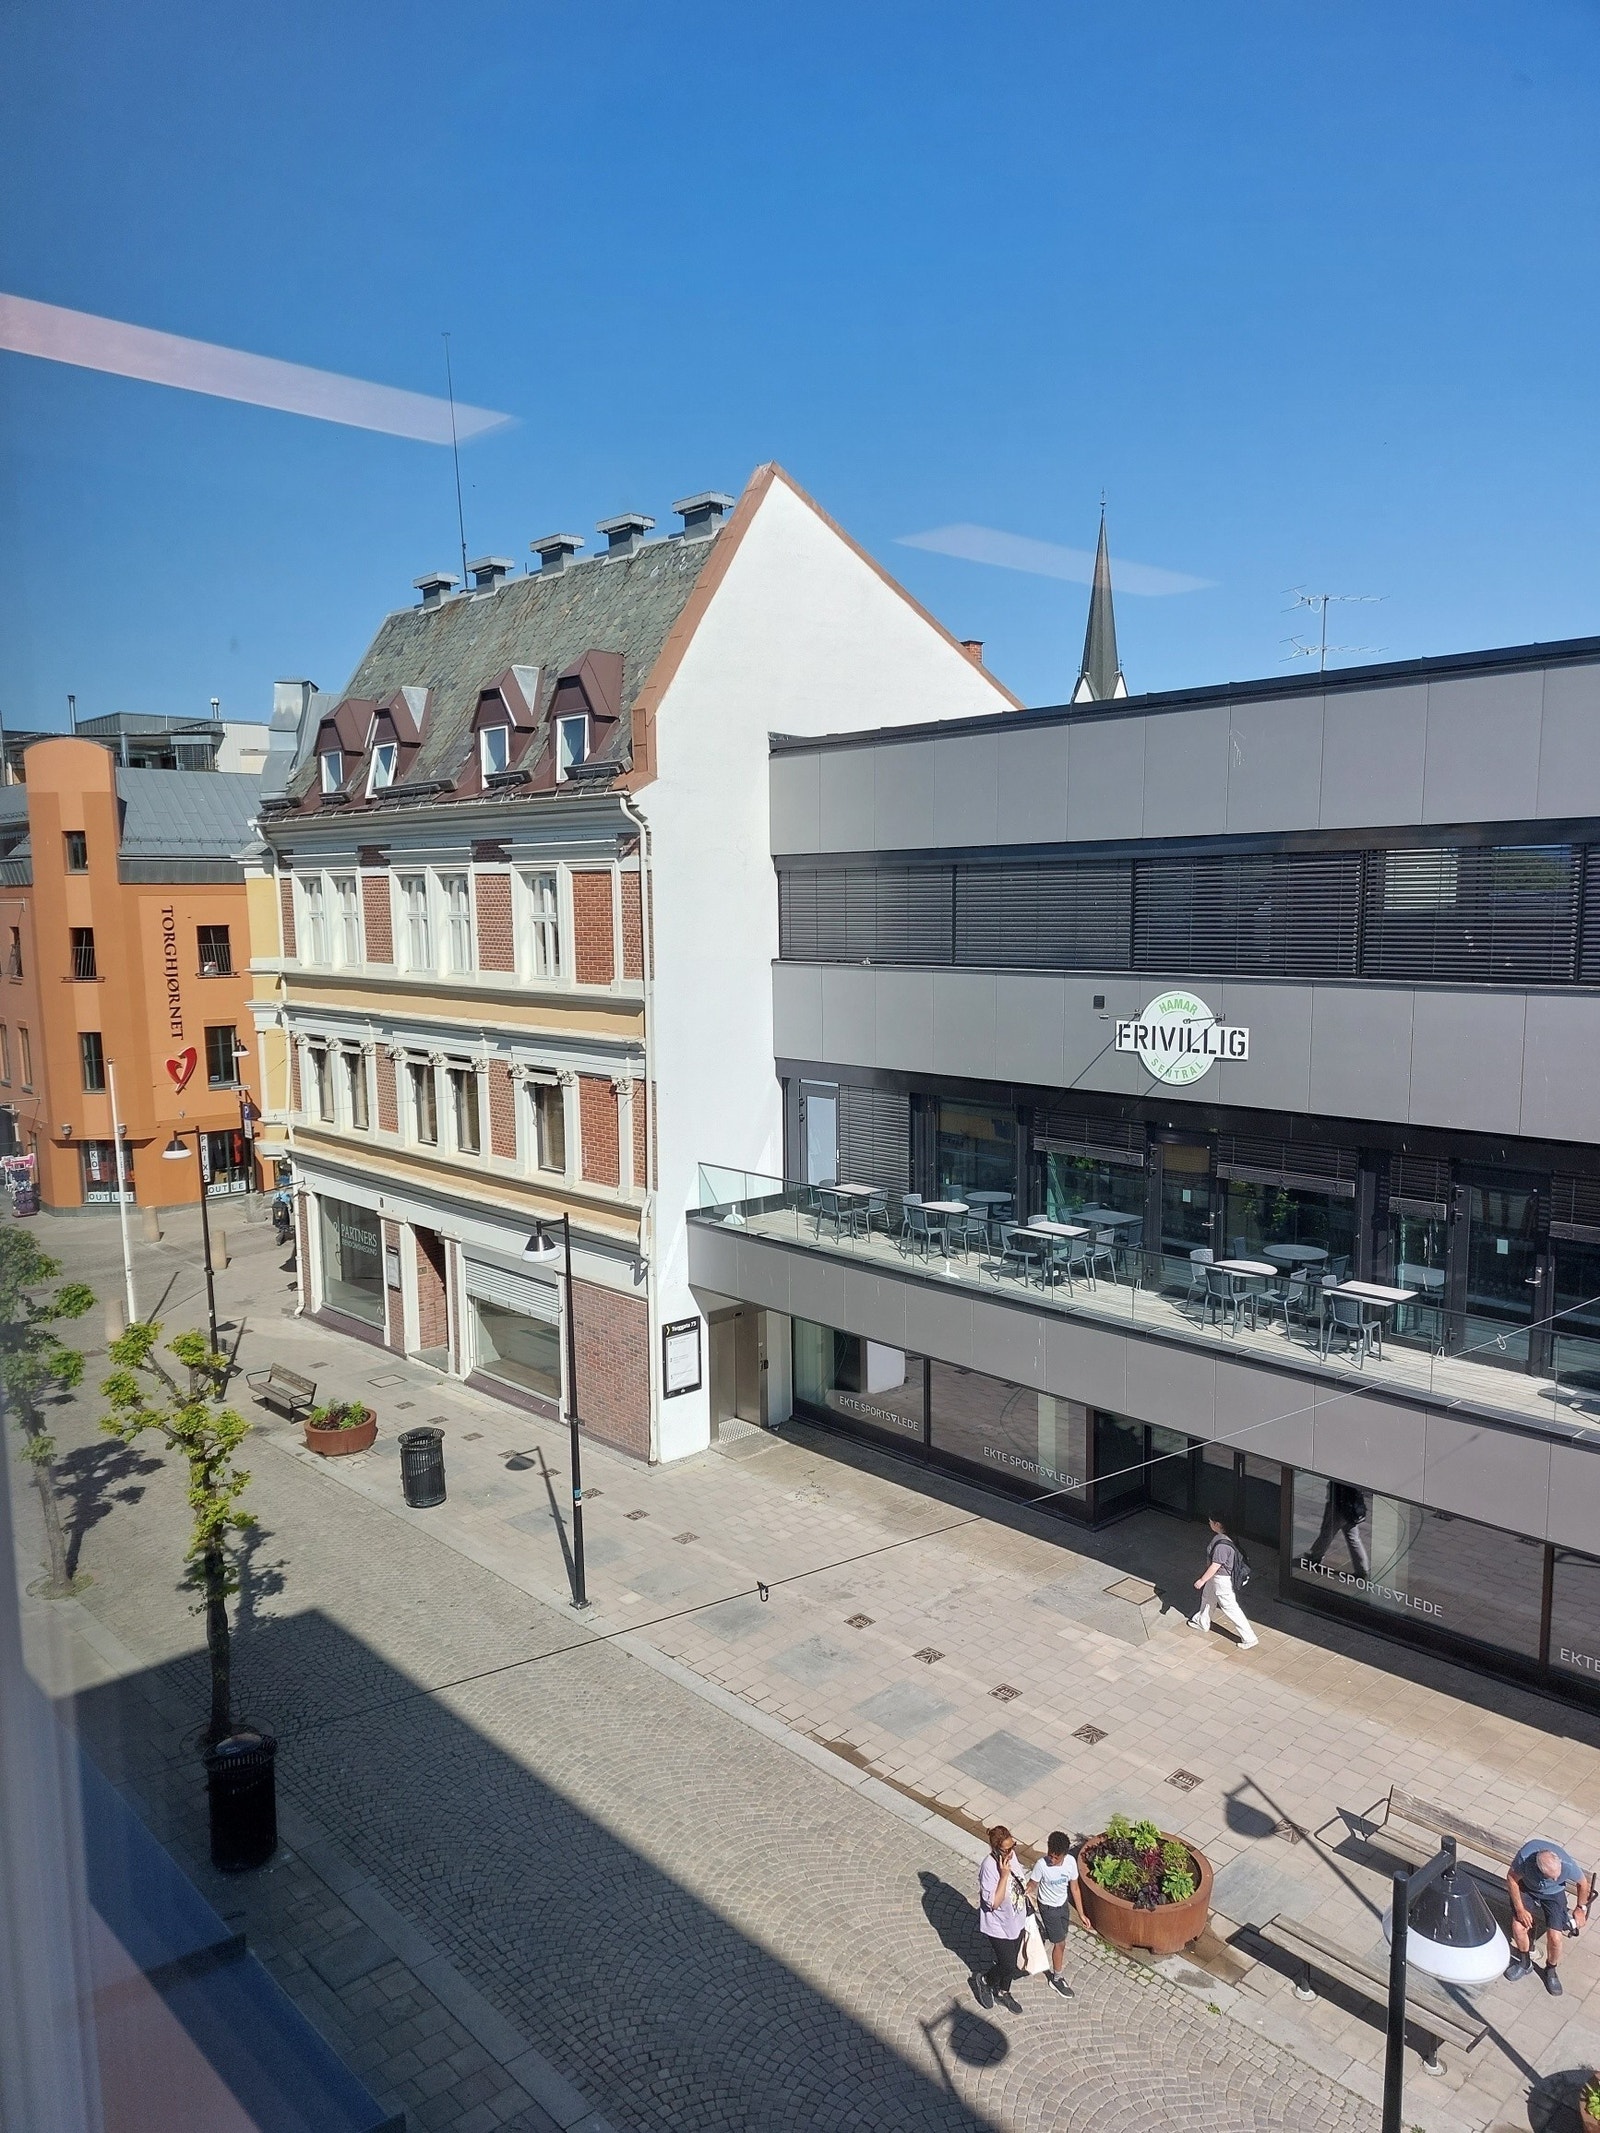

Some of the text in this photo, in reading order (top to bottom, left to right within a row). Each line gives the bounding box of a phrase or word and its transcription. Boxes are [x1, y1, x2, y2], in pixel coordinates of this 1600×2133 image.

[161, 905, 184, 1041] TORGHJØRNET
[1158, 998, 1199, 1016] HAMAR
[1118, 1023, 1247, 1057] FRIVILLIG
[1151, 1058, 1204, 1080] SENTRAL
[89, 1141, 99, 1168] SKO
[200, 1135, 210, 1181] PRIXO
[89, 1193, 132, 1201] OUTLT
[340, 1223, 378, 1248] PARTNERS
[839, 1395, 860, 1411] EKTE
[983, 1446, 1008, 1463] EKTE
[1300, 1557, 1335, 1580] EKTE
[1560, 1647, 1600, 1673] EKTE
